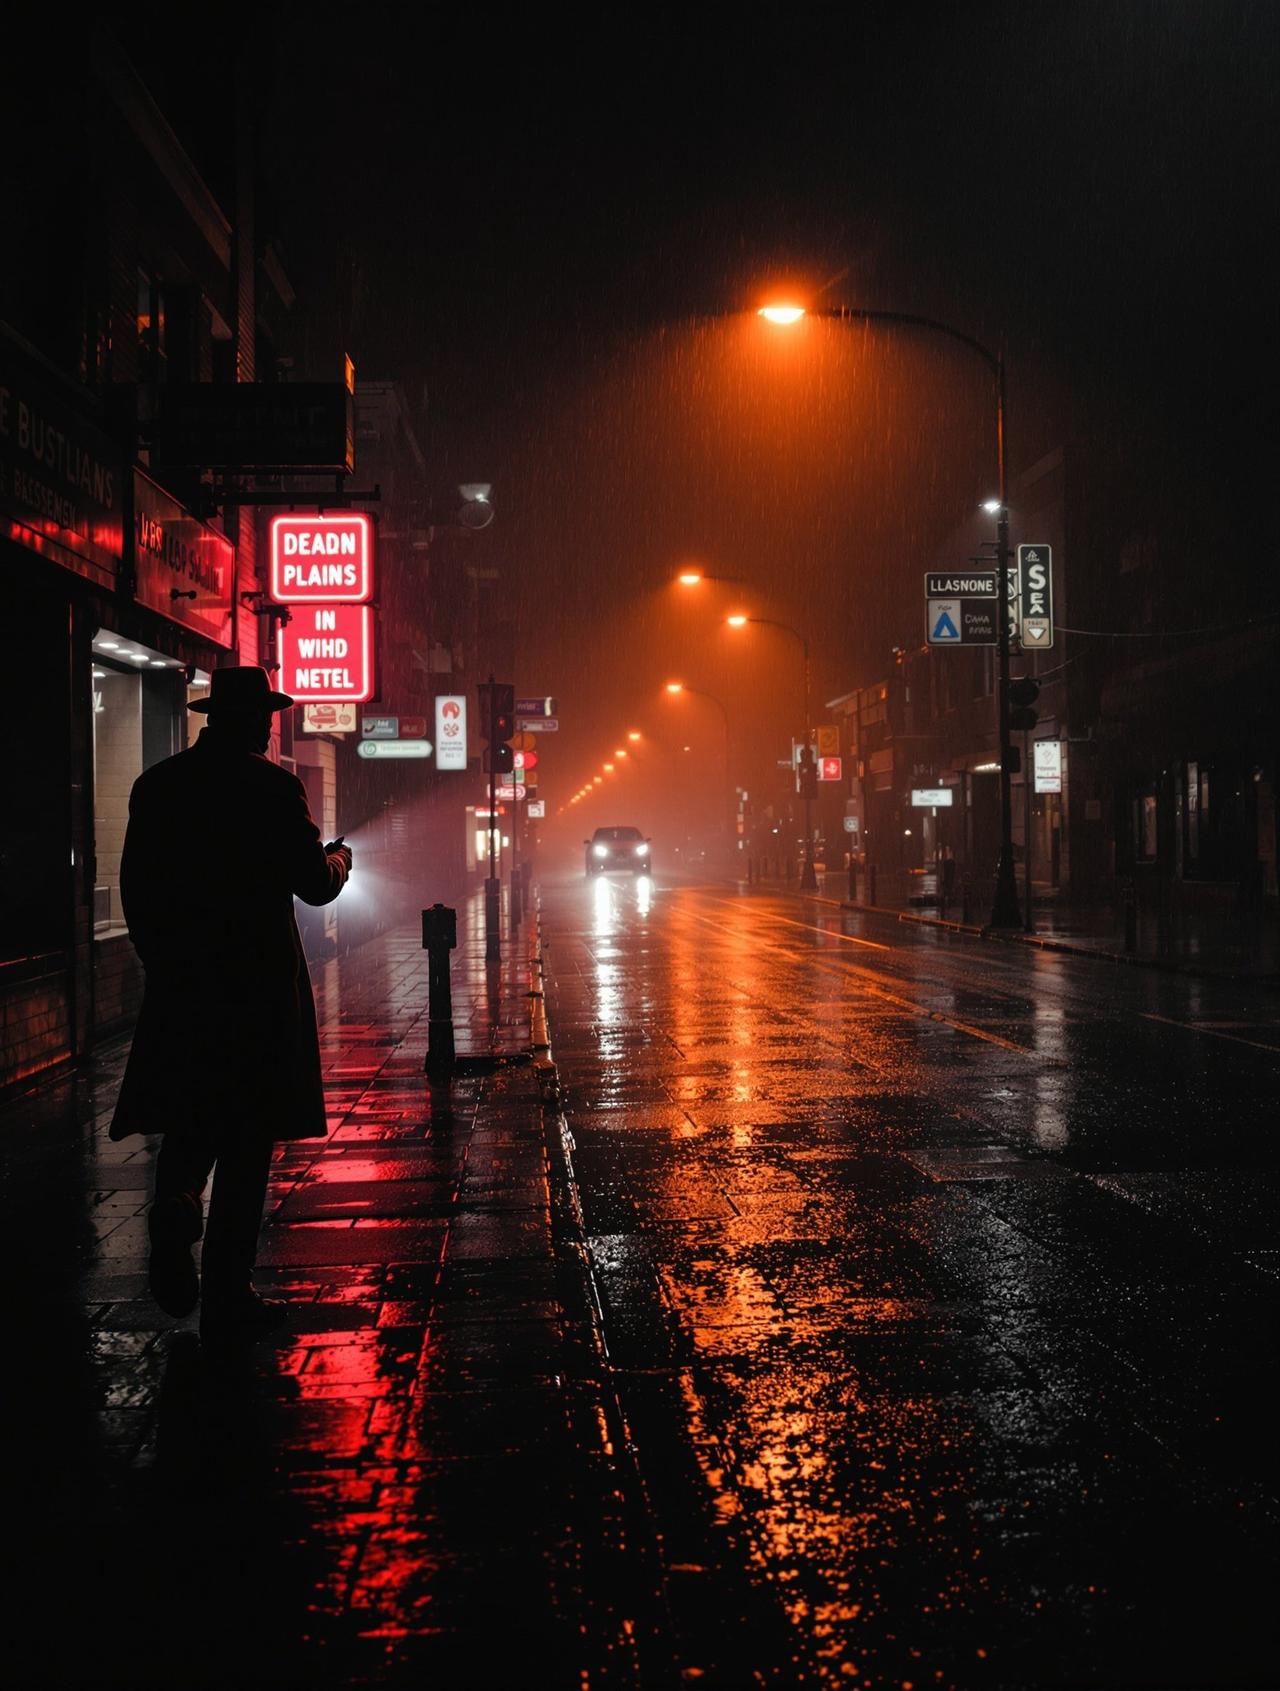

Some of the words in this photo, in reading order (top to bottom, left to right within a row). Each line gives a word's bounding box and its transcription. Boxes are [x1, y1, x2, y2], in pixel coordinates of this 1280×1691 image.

[283, 564, 356, 587] PLAINS
[930, 579, 993, 592] LLASNONE
[315, 610, 336, 631] IN
[297, 638, 348, 659] WIHD
[295, 668, 355, 689] NETEL
